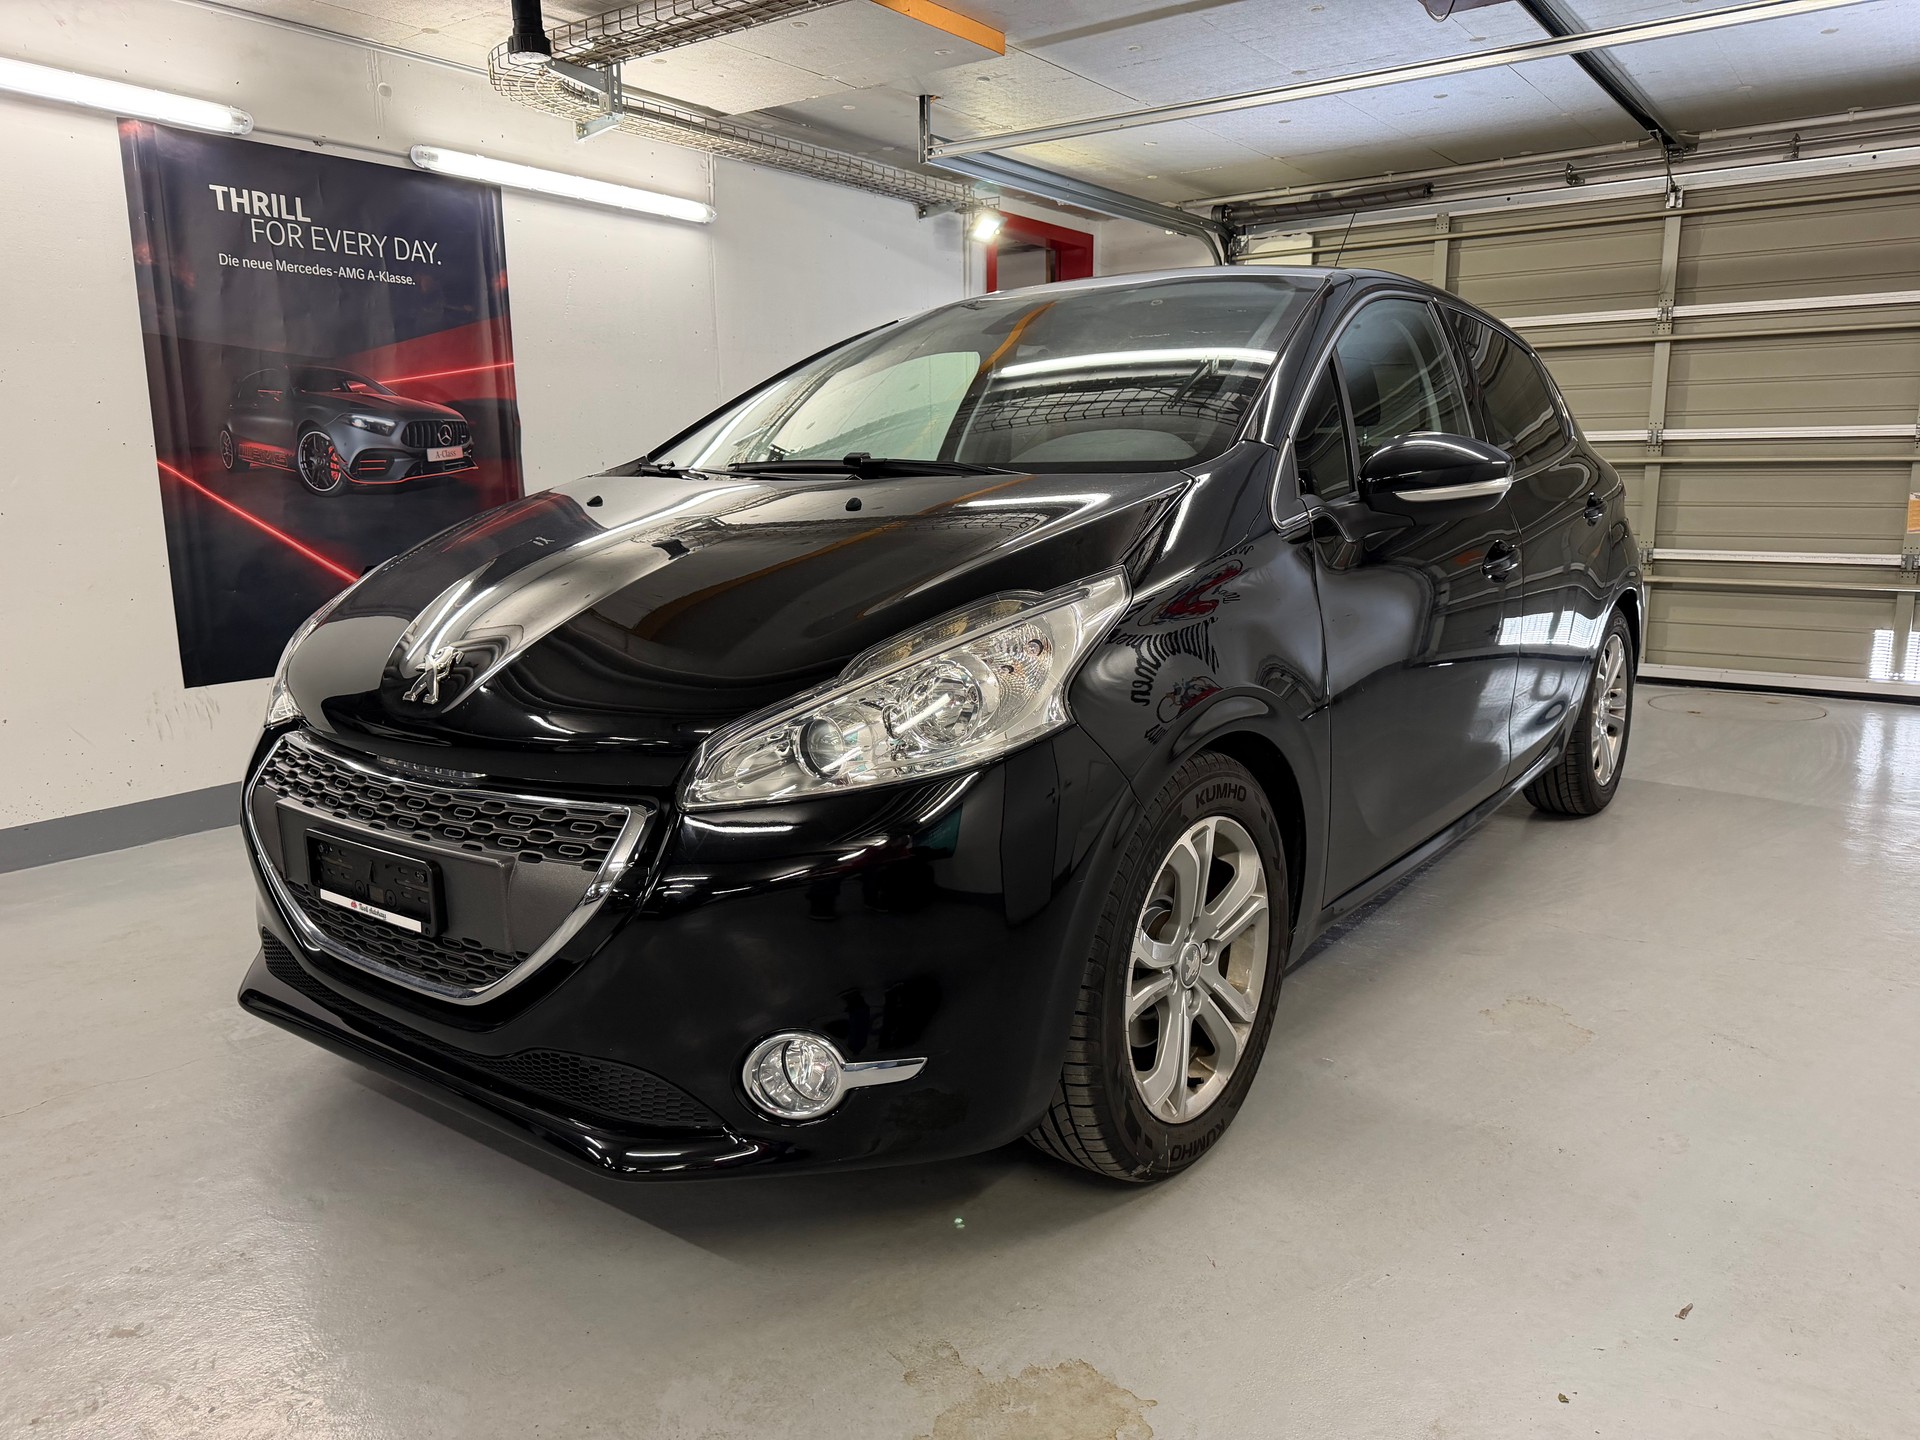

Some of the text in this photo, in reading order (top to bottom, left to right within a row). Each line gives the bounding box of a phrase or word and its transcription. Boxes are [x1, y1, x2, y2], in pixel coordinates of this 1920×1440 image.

[208, 184, 311, 223] THRILL
[251, 218, 443, 266] FOR EVERY DAY.
[218, 253, 416, 286] Die neue Mercedes-AMG A-Klasse.
[435, 450, 457, 459] A-Class
[1195, 782, 1247, 809] KUMHO
[1170, 1118, 1225, 1162] KUMHO
